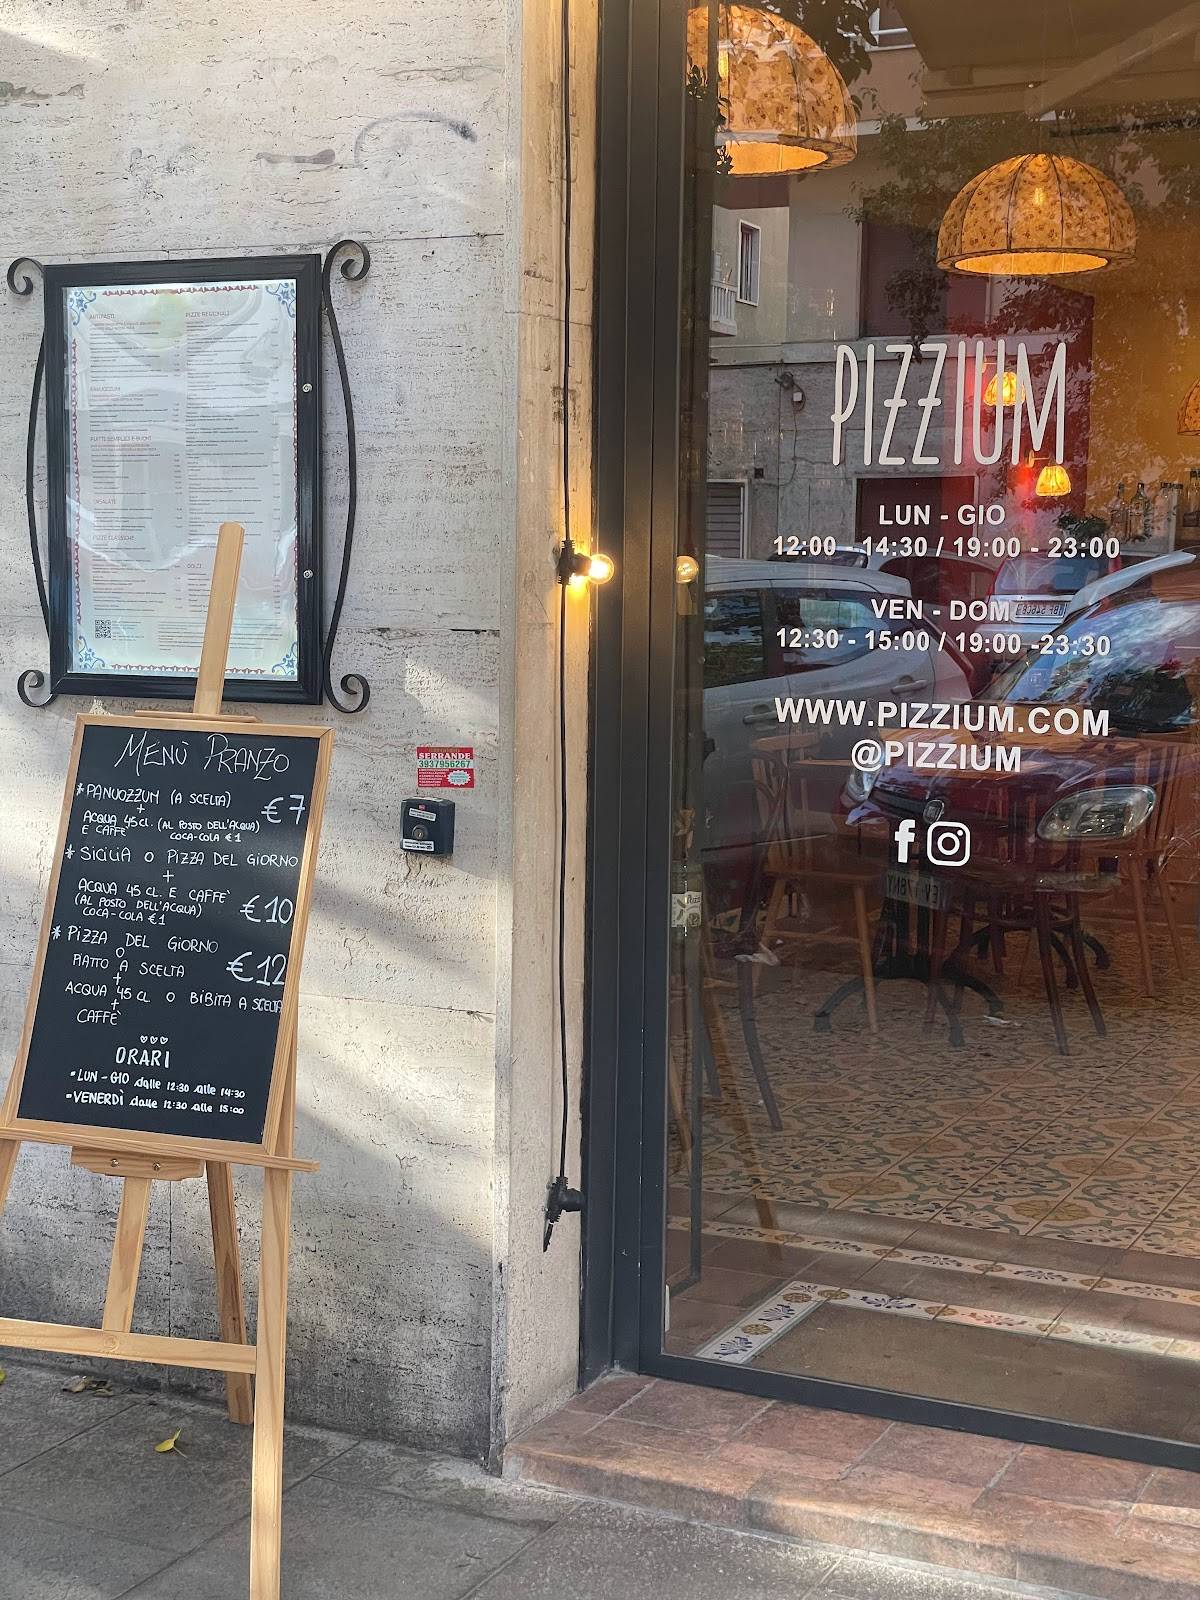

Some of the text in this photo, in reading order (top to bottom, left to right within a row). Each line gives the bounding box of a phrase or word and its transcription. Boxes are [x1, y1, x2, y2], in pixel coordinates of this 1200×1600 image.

[830, 339, 1067, 465] PIZZIUM
[879, 504, 931, 525] LUN
[957, 504, 1006, 525] GIO
[773, 535, 837, 556] 12:00
[862, 536, 928, 557] 14:30
[953, 537, 1022, 558] 19:00
[1047, 537, 1120, 559] 23:00
[870, 598, 923, 620] VEN
[950, 600, 1011, 622] DOM
[775, 627, 840, 649] 12:30
[864, 630, 930, 651] 15:00
[955, 632, 1022, 654] 19:00
[774, 697, 1111, 737] WWW.PIZZIUM.COM
[114, 731, 290, 780] MENÙ PRANZO
[418, 760, 471, 768] 3937956267
[851, 738, 1022, 773] @PIZZIUM
[190, 791, 231, 807] SCELTA)
[83, 811, 117, 826] ACQUA
[179, 820, 202, 831] POSTO
[170, 832, 220, 842] COCA-COLA
[168, 849, 204, 865] PIZZA
[213, 852, 238, 867] DEL
[247, 852, 299, 868] GIORNO
[78, 878, 118, 896] ACQUA
[126, 883, 141, 897] 45
[169, 887, 177, 898] E
[98, 897, 127, 909] POSTO
[82, 906, 143, 922] COCA-COLA
[67, 925, 219, 953] PIZZA DEL GIORNO
[73, 953, 185, 977] PIATTO A SCELTA
[65, 982, 107, 997] ACQUA
[117, 986, 132, 1000] 45
[239, 997, 247, 1010] A
[115, 1047, 170, 1068] ORARI
[110, 1072, 129, 1085] GIO
[134, 1075, 161, 1090] dalle
[167, 1081, 190, 1093] 12:30
[193, 1083, 216, 1096] alle
[220, 1087, 246, 1099] 14:30
[129, 1095, 158, 1109] dalle
[163, 1099, 187, 1110] 12:30
[191, 1102, 213, 1113] alle
[219, 1104, 245, 1115] 15:00
